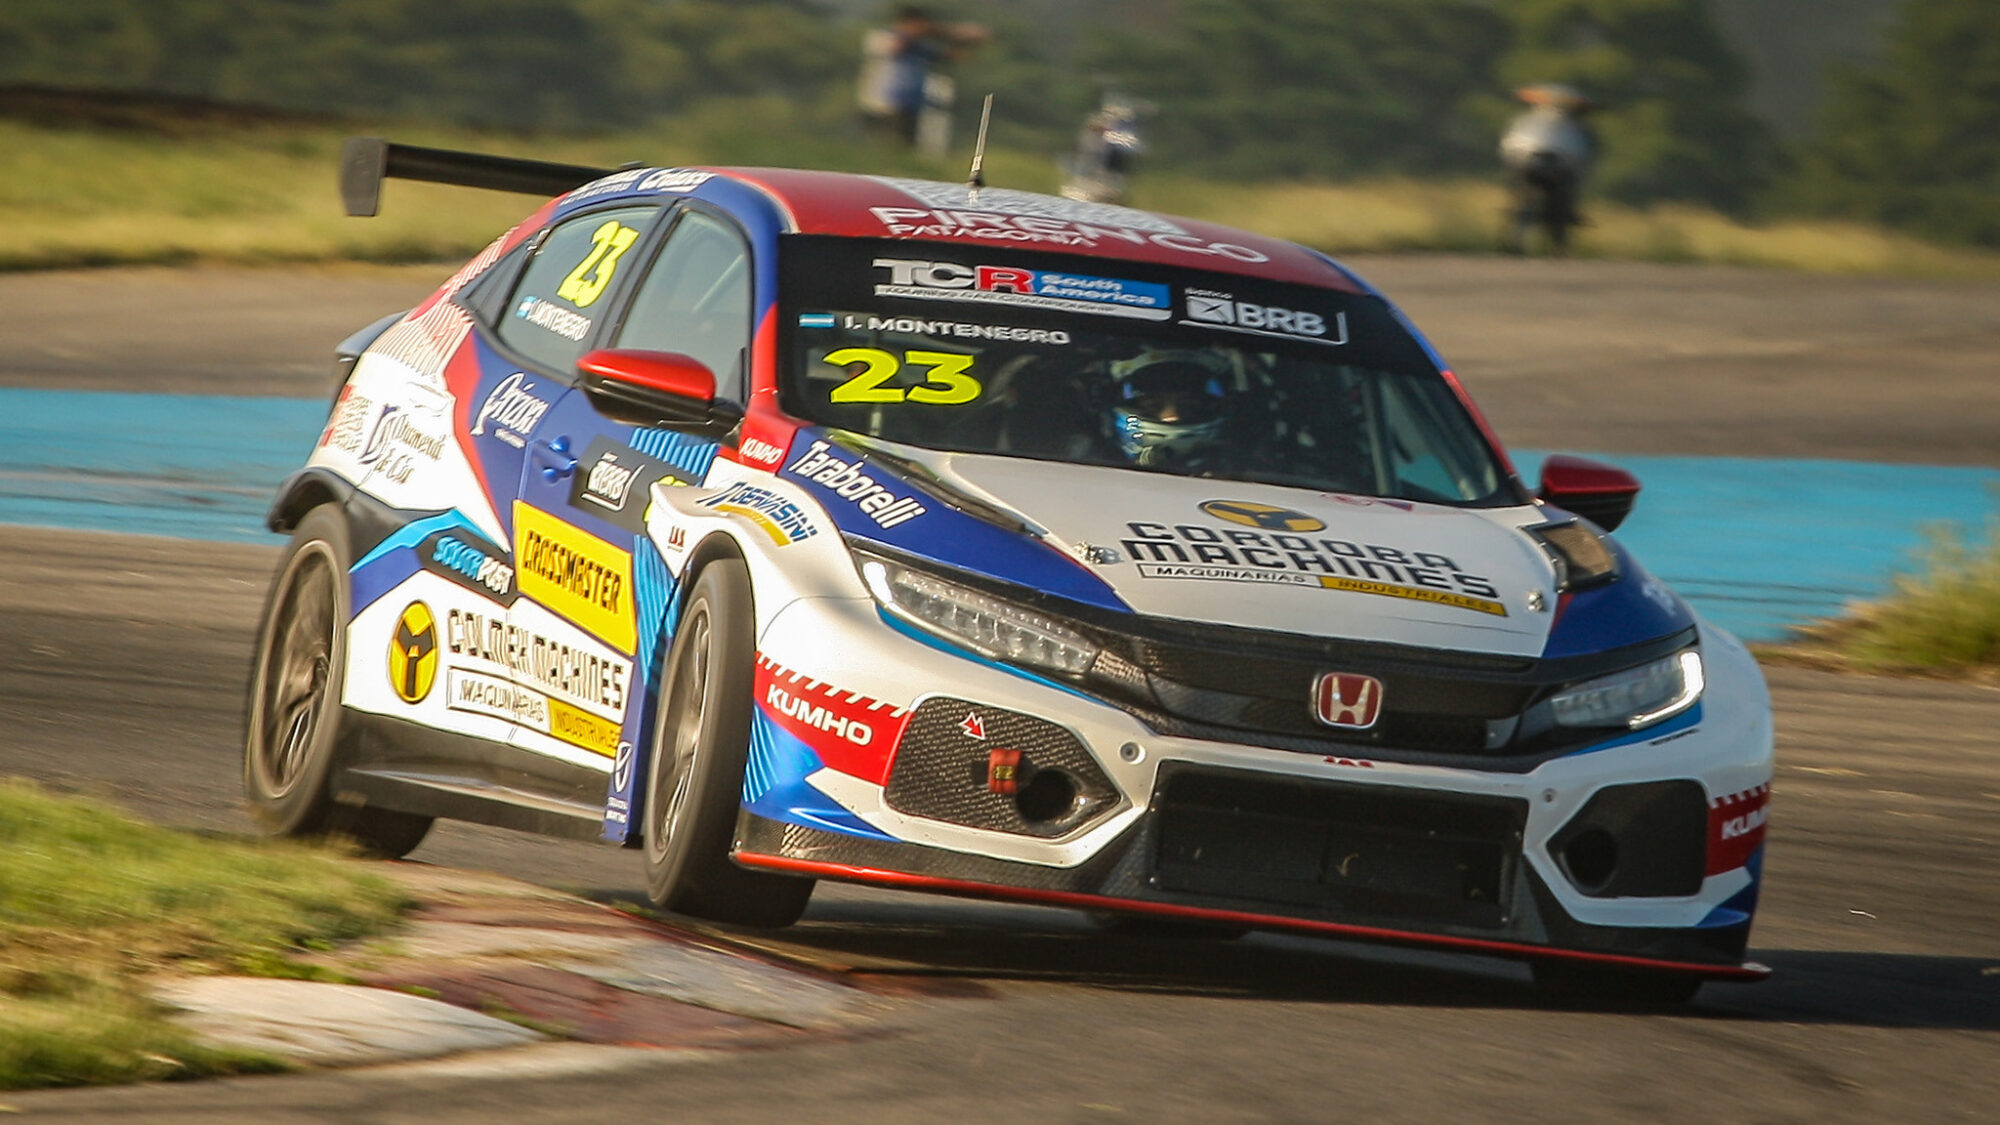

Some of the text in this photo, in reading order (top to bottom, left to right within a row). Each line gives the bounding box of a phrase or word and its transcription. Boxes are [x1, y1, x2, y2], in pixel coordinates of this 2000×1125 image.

[868, 206, 1269, 263] PIRENCO
[556, 220, 639, 308] 23
[872, 258, 1036, 294] TCR
[1041, 273, 1123, 291] South
[1039, 285, 1156, 305] America
[1235, 302, 1327, 336] BRB
[867, 317, 1071, 345] MONTENEGRO
[823, 348, 982, 404] 23
[739, 437, 783, 465] KUMHO
[788, 440, 927, 530] Taraborelli
[523, 530, 622, 615] CROSSMASTER
[1120, 540, 1500, 598] MACHINES
[1126, 522, 1463, 572] CORDOBA
[1156, 566, 1494, 612] MAQUINARIAS INDUSTRIALES
[532, 633, 624, 710] MACHINES
[766, 684, 872, 746] KUMHO
